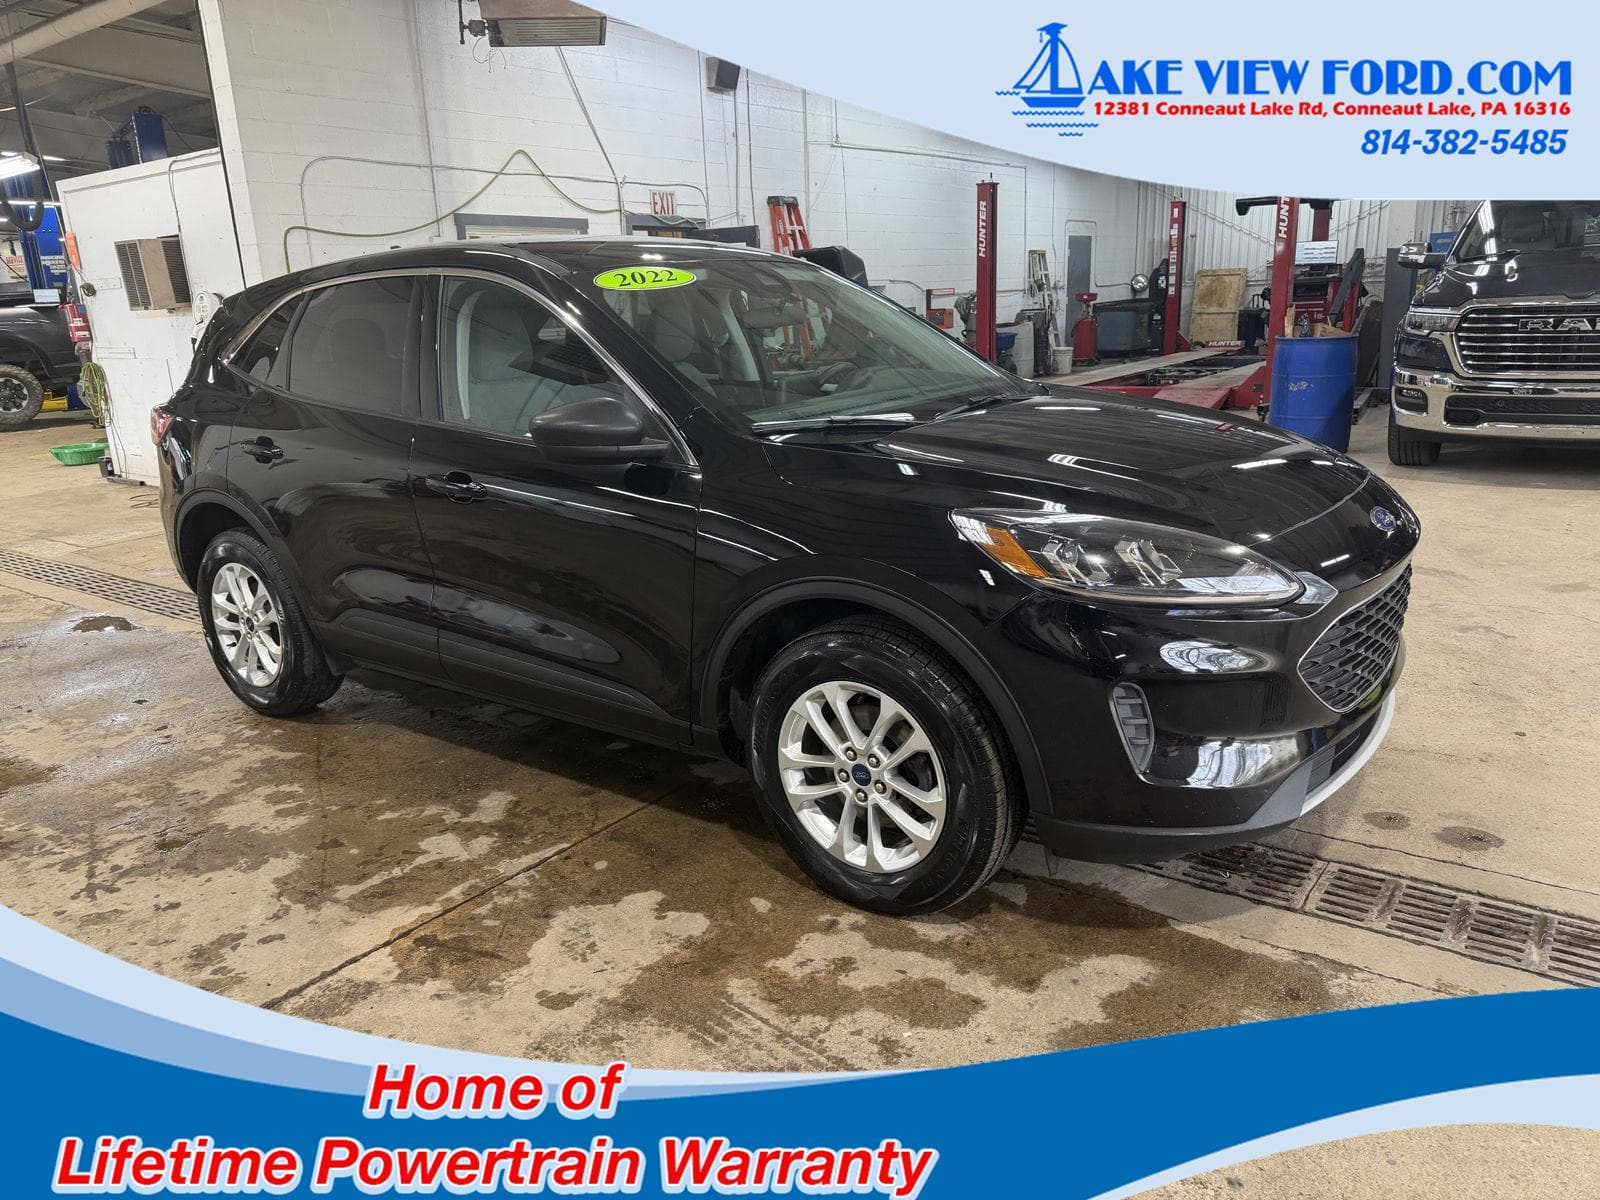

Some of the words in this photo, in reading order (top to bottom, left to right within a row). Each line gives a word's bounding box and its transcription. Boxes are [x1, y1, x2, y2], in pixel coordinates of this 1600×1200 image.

[652, 191, 675, 215] EXIT
[978, 200, 988, 258] HUNTER
[613, 269, 678, 287] 2022
[1518, 317, 1600, 331] RA
